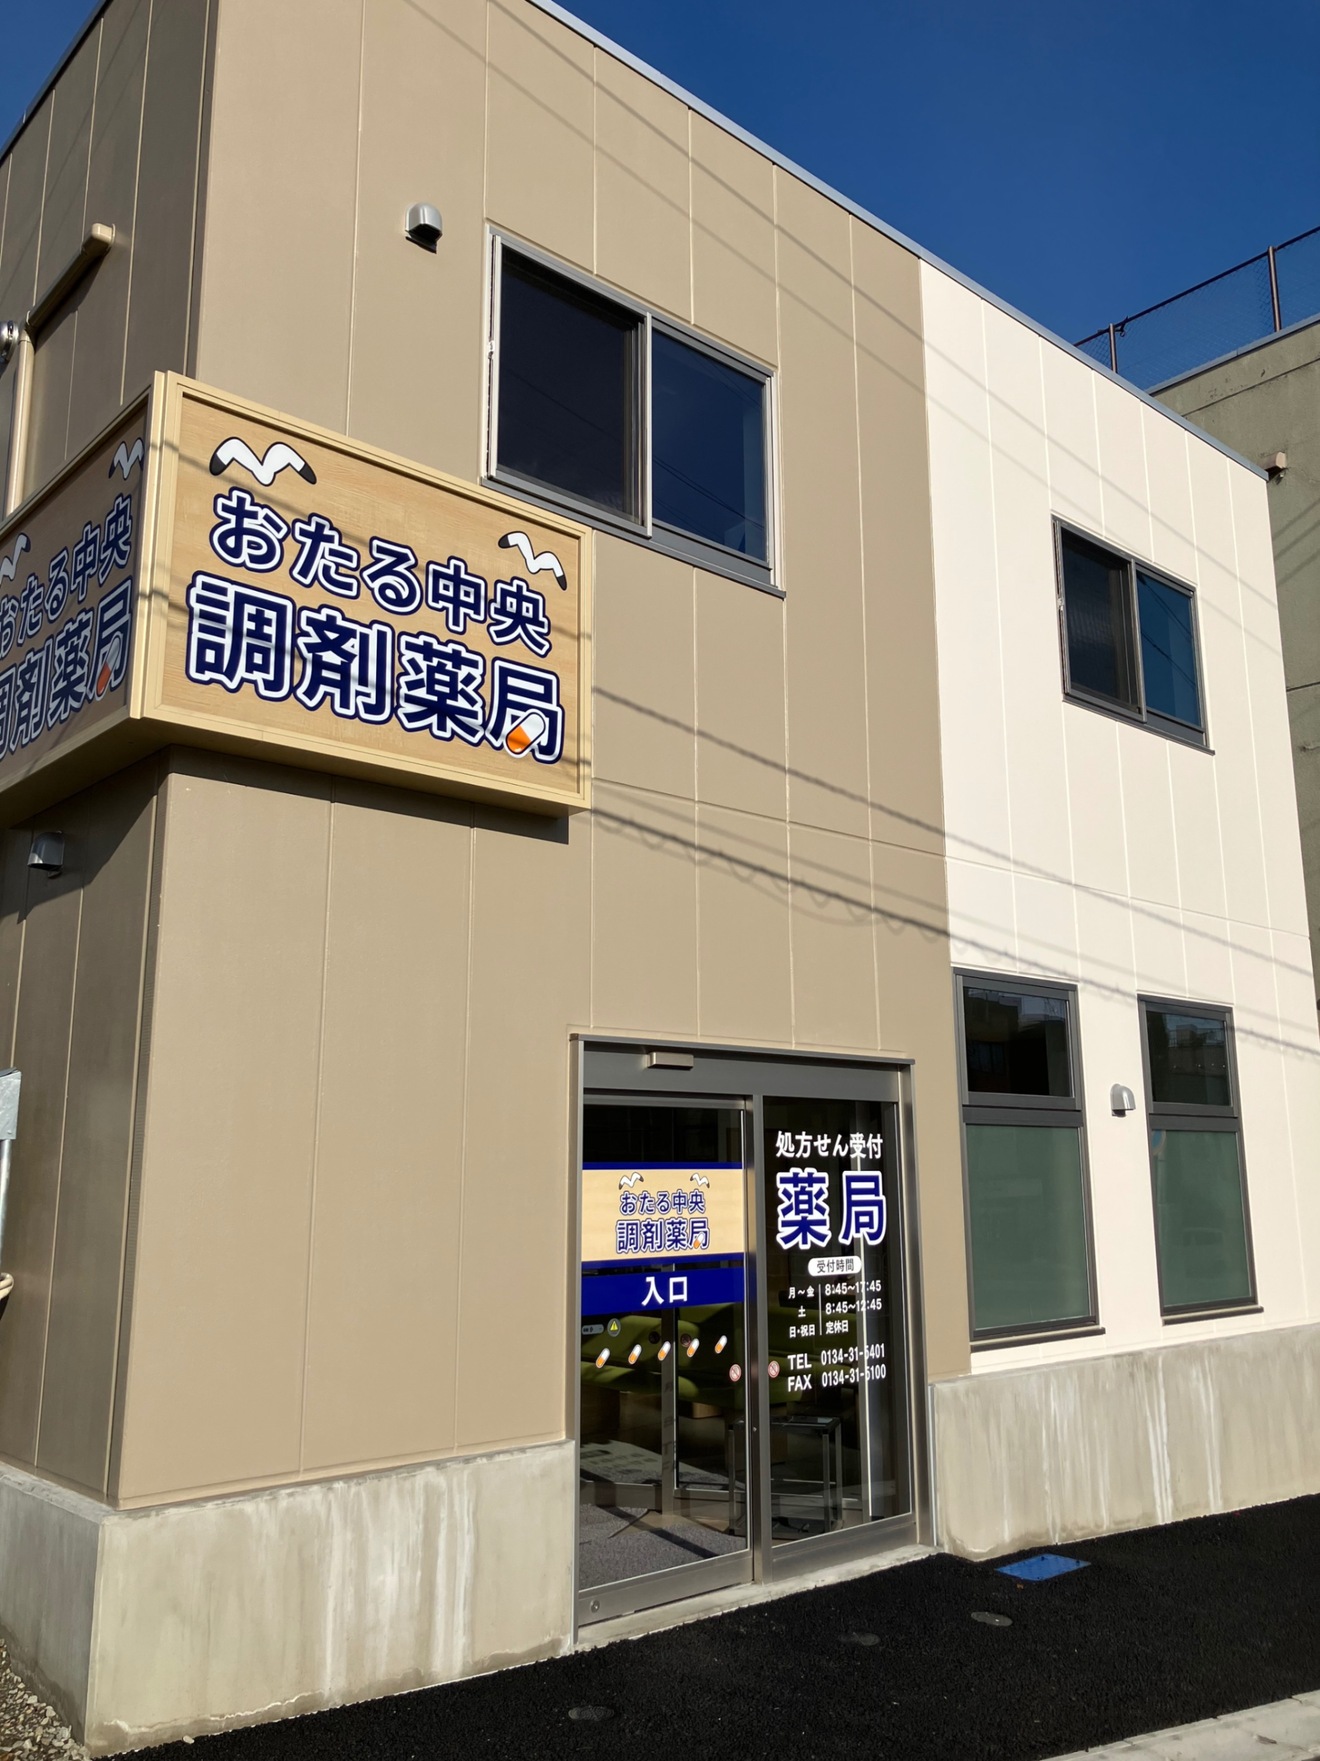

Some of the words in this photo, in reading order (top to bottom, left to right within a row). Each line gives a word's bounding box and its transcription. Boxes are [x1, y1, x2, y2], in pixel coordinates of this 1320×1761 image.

[210, 487, 552, 658] おたる中央
[186, 571, 565, 764] 調剤薬局
[775, 1131, 884, 1160] 処方せん受付
[619, 1188, 706, 1216] おたる中央
[776, 1166, 887, 1250] 薬局
[615, 1216, 711, 1254] 調剤薬局
[816, 1258, 855, 1274] 受付時間
[641, 1276, 688, 1307] 入口
[797, 1305, 806, 1318] 土
[825, 1320, 849, 1335] 定休日
[787, 1353, 812, 1370] TEL
[820, 1343, 885, 1366] 0134-31-5401
[787, 1374, 812, 1392] FAX
[821, 1364, 887, 1387] 0134-31-5100
